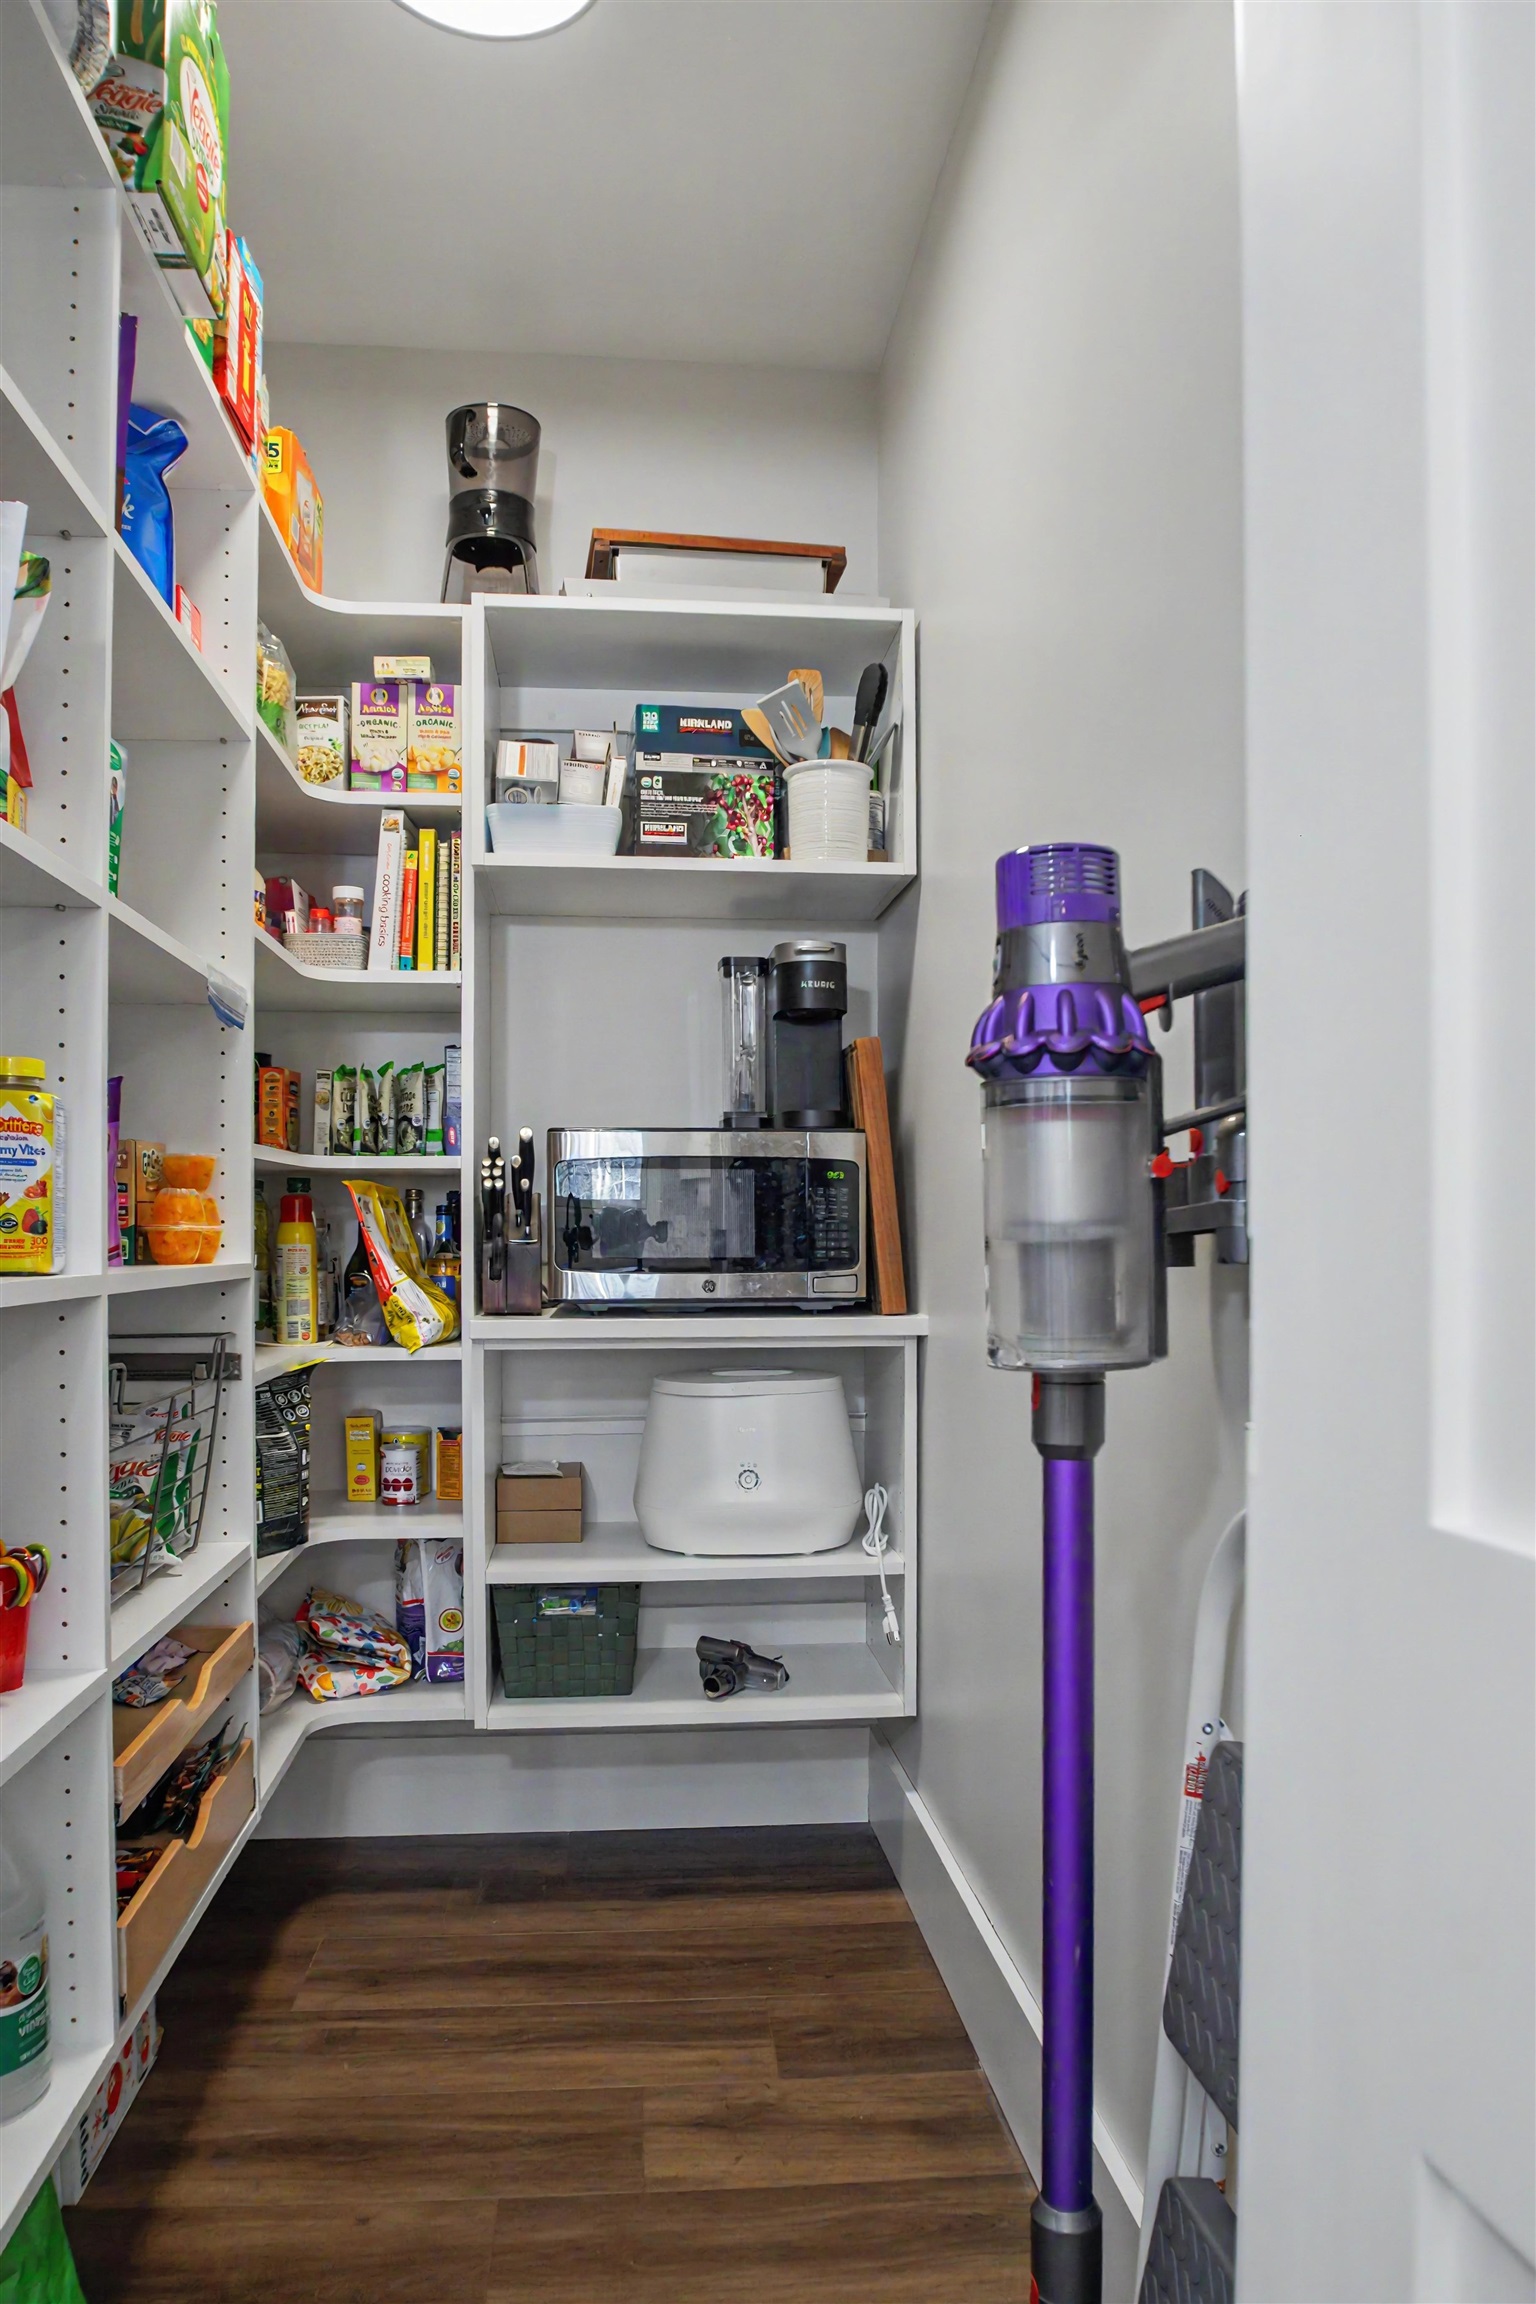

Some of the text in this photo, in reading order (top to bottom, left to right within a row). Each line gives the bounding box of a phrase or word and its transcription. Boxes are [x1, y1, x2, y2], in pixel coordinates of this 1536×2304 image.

[360, 718, 398, 729] ORGANIC
[415, 718, 454, 729] ORGANIC
[679, 717, 733, 730] KIRKLAND
[378, 873, 392, 913] cooking
[377, 914, 390, 948] basics
[800, 980, 836, 989] KEURIG
[18, 1143, 47, 1156] Vites
[30, 1236, 48, 1246] 300
